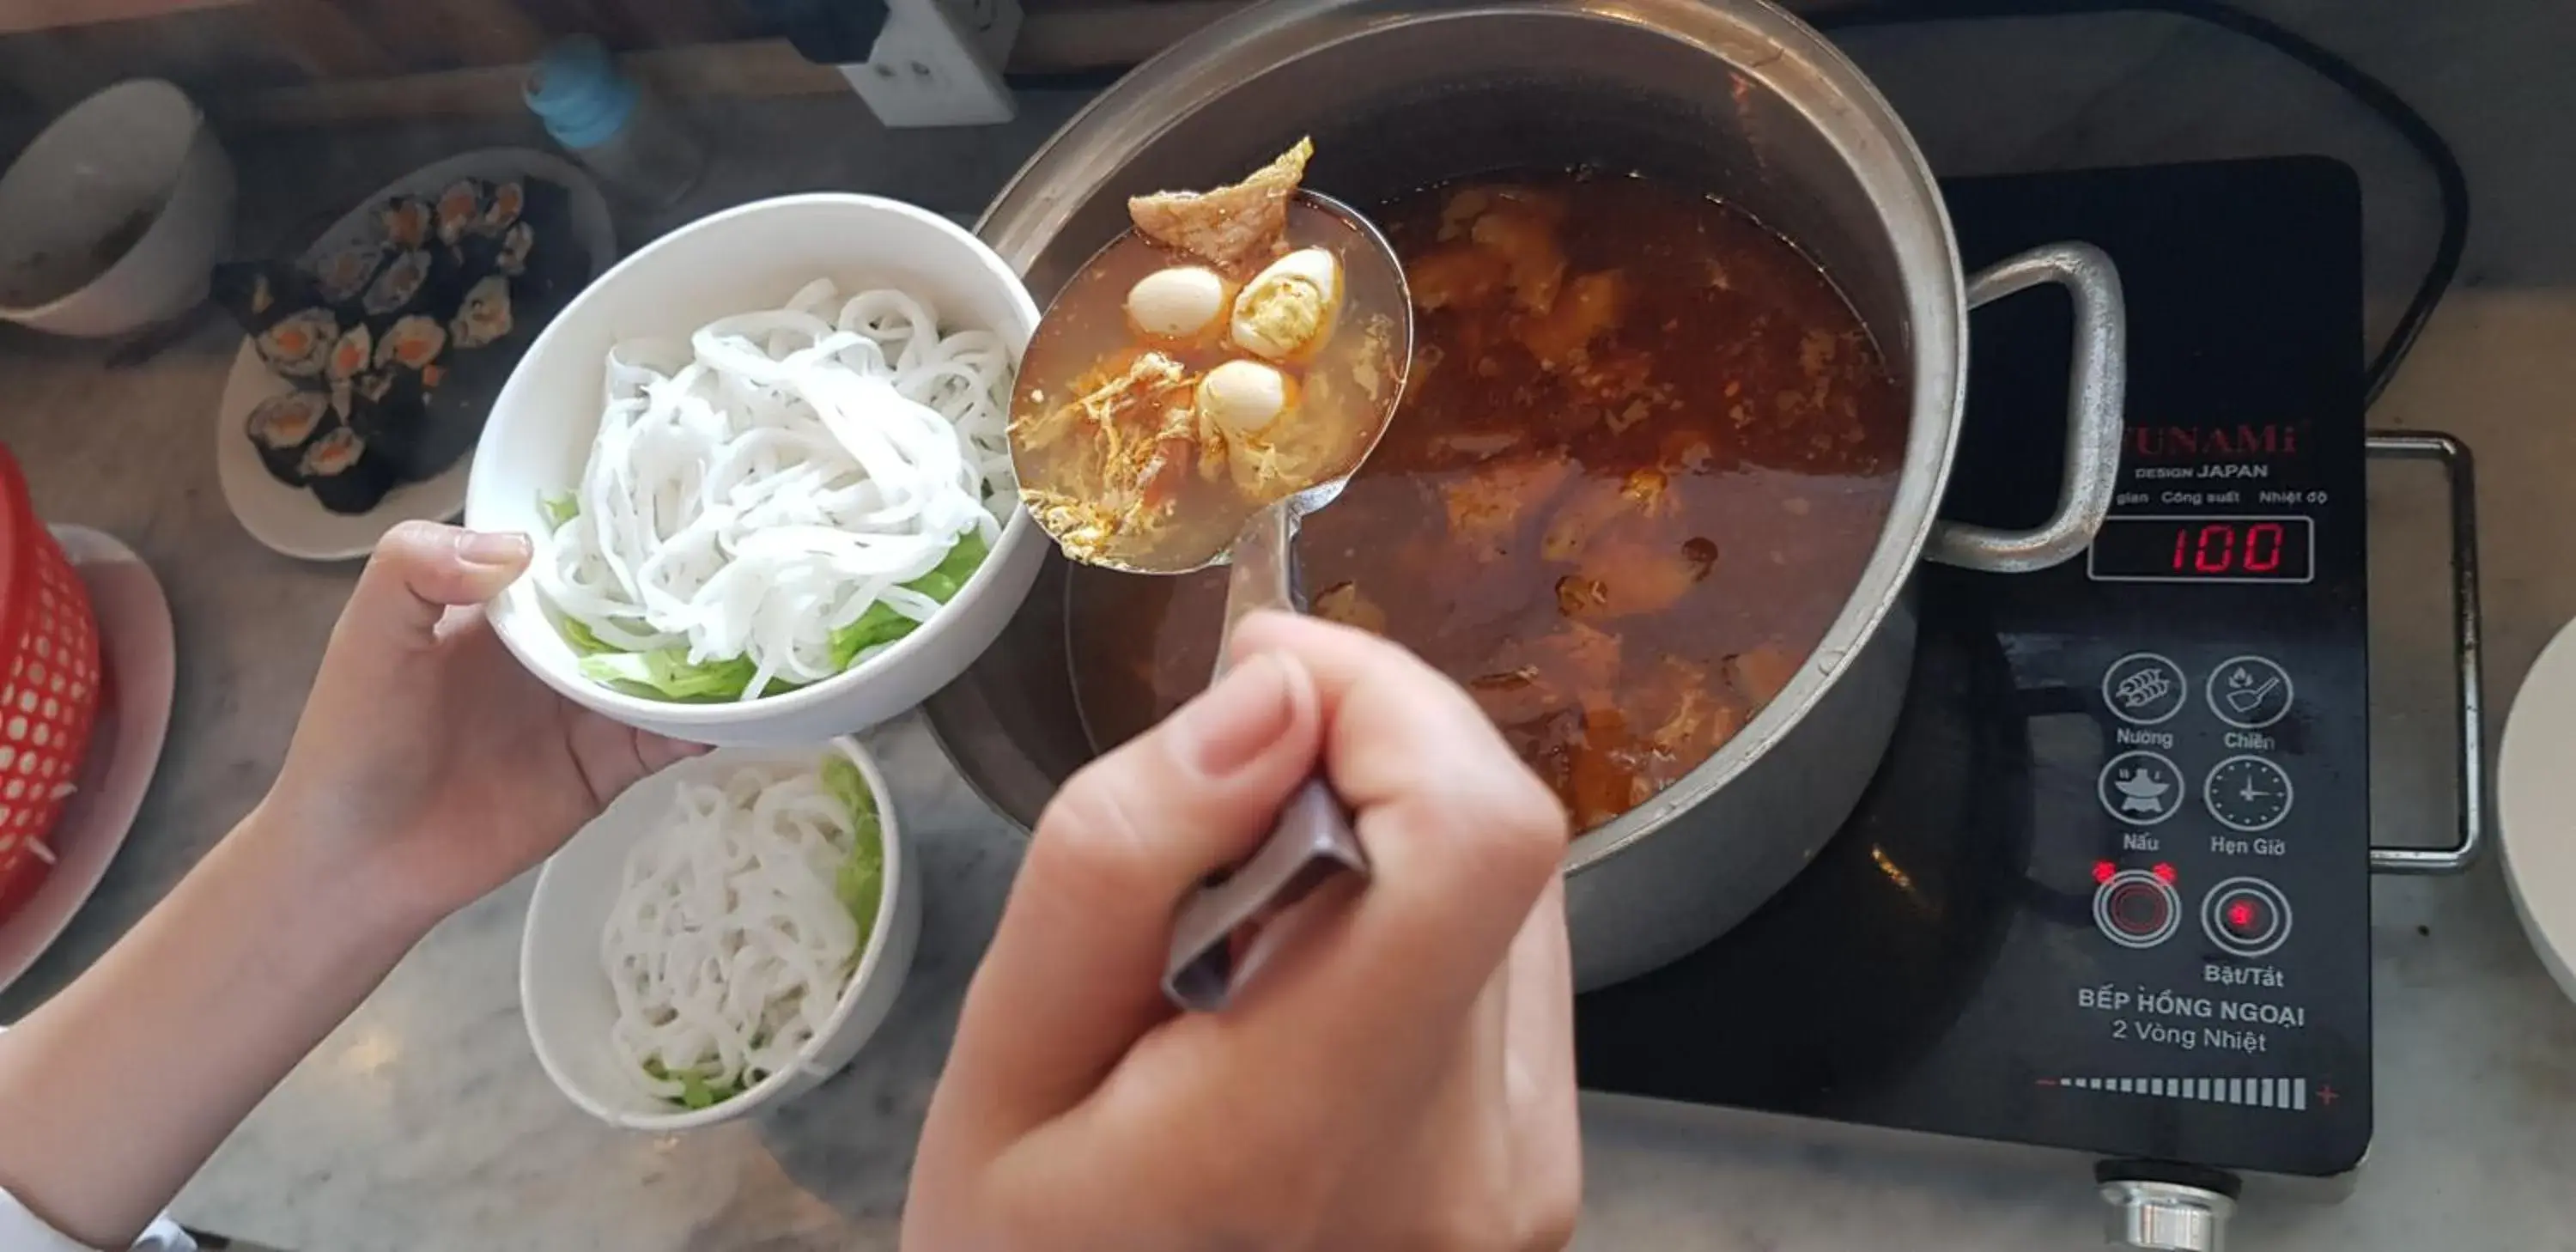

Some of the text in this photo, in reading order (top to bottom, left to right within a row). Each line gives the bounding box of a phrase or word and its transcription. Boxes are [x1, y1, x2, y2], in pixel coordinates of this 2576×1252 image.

[2123, 424, 2296, 454] UNAMi
[2136, 465, 2268, 478] DESIGN JAPAN
[2161, 491, 2202, 505] Công
[2259, 491, 2302, 505] Nhiệt
[2306, 490, 2328, 505] độ
[2172, 523, 2283, 572] 100
[2123, 831, 2160, 851] Nấu
[2210, 836, 2248, 854] Hẹn
[2078, 983, 2130, 1010] BẾP
[2221, 1000, 2306, 1028] NGOẠI
[2112, 1019, 2267, 1054] 2 Vòng Nhiệt
